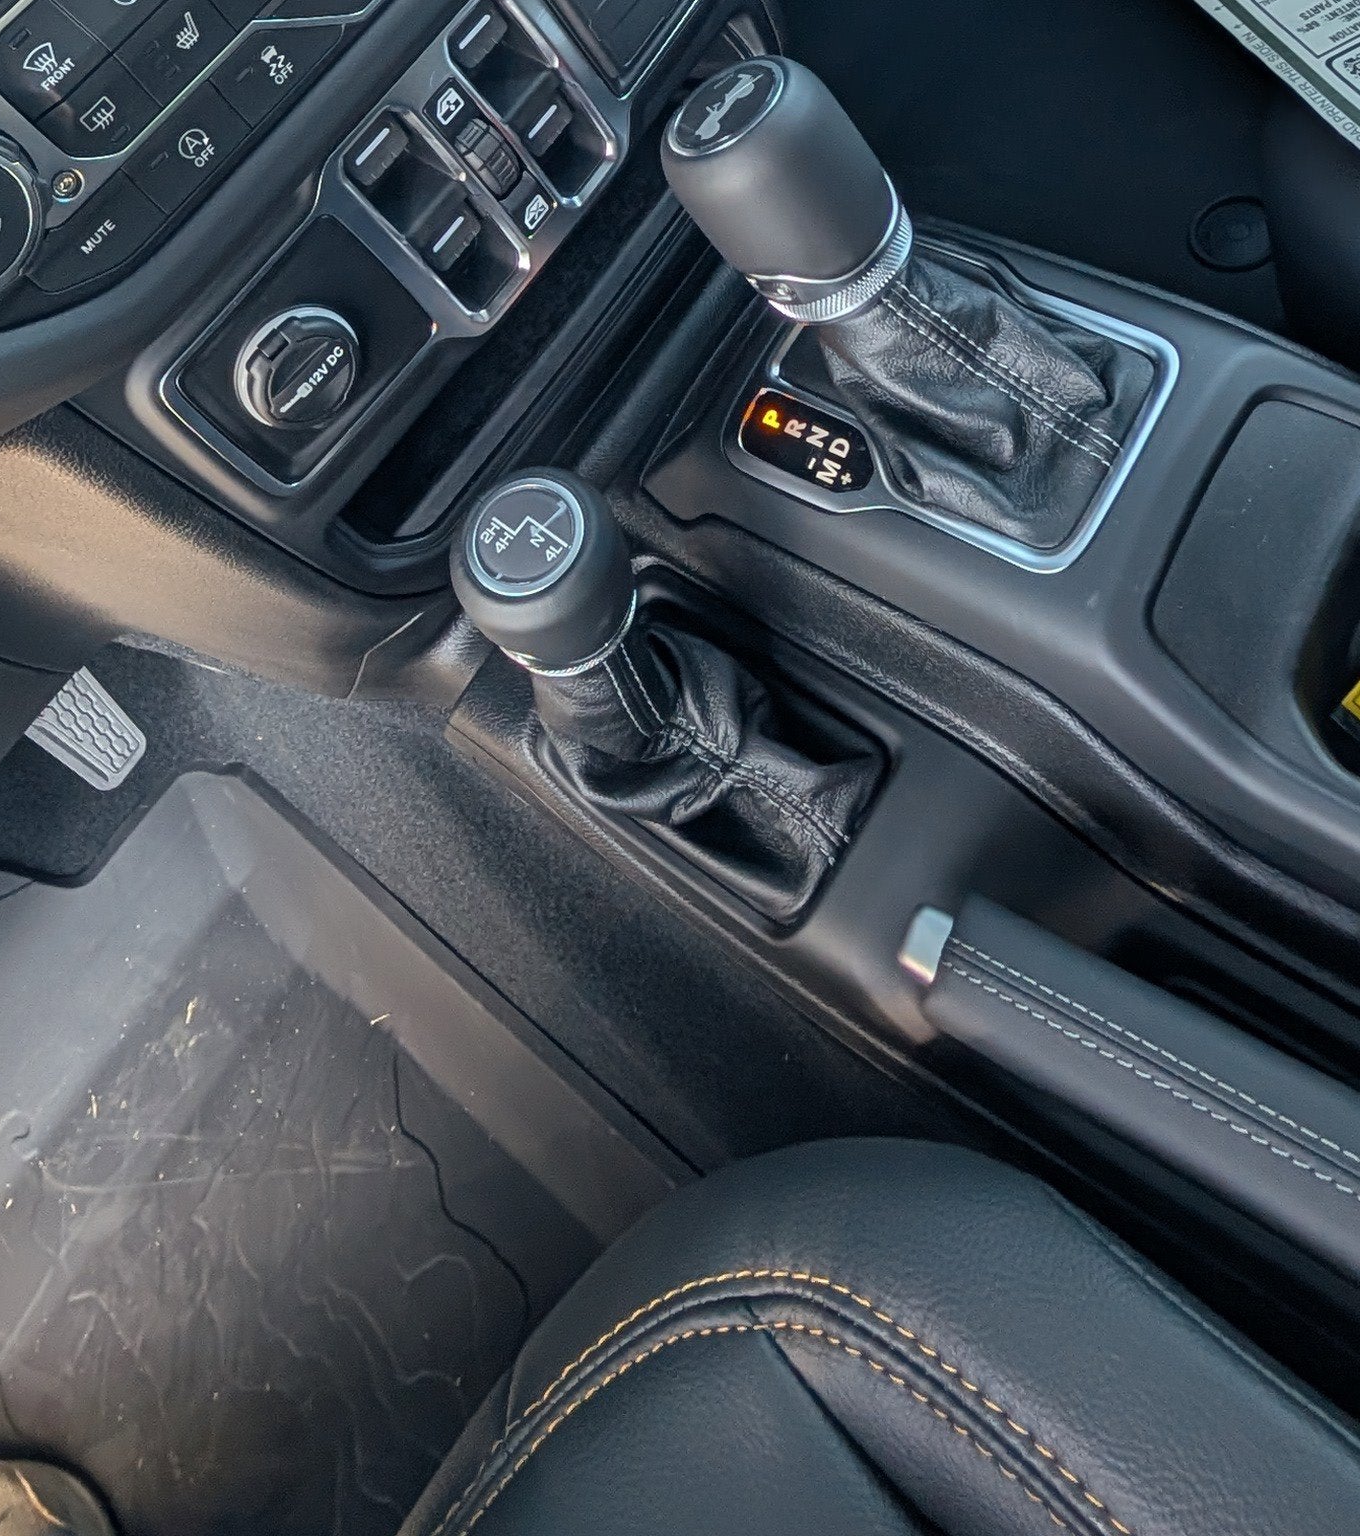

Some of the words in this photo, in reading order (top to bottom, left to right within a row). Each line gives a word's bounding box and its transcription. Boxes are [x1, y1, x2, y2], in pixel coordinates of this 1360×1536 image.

[1298, 0, 1332, 20] PARTS
[1242, 31, 1257, 44] IN
[1252, 42, 1279, 63] SIDE
[40, 57, 76, 91] FRONT
[274, 61, 294, 85] OFF
[1276, 61, 1299, 84] THIS
[1298, 81, 1342, 124] PRINTER
[194, 144, 215, 168] OFF
[80, 219, 116, 254] MUTE
[308, 363, 329, 387] 12V
[326, 345, 344, 367] DC
[762, 409, 782, 431] P
[784, 418, 806, 440] R
[805, 424, 830, 448] N
[828, 438, 851, 459] D
[816, 462, 842, 486] M
[480, 521, 500, 544] 2H
[495, 531, 514, 554] 4H
[529, 535, 546, 549] N
[546, 545, 563, 562] 4L
